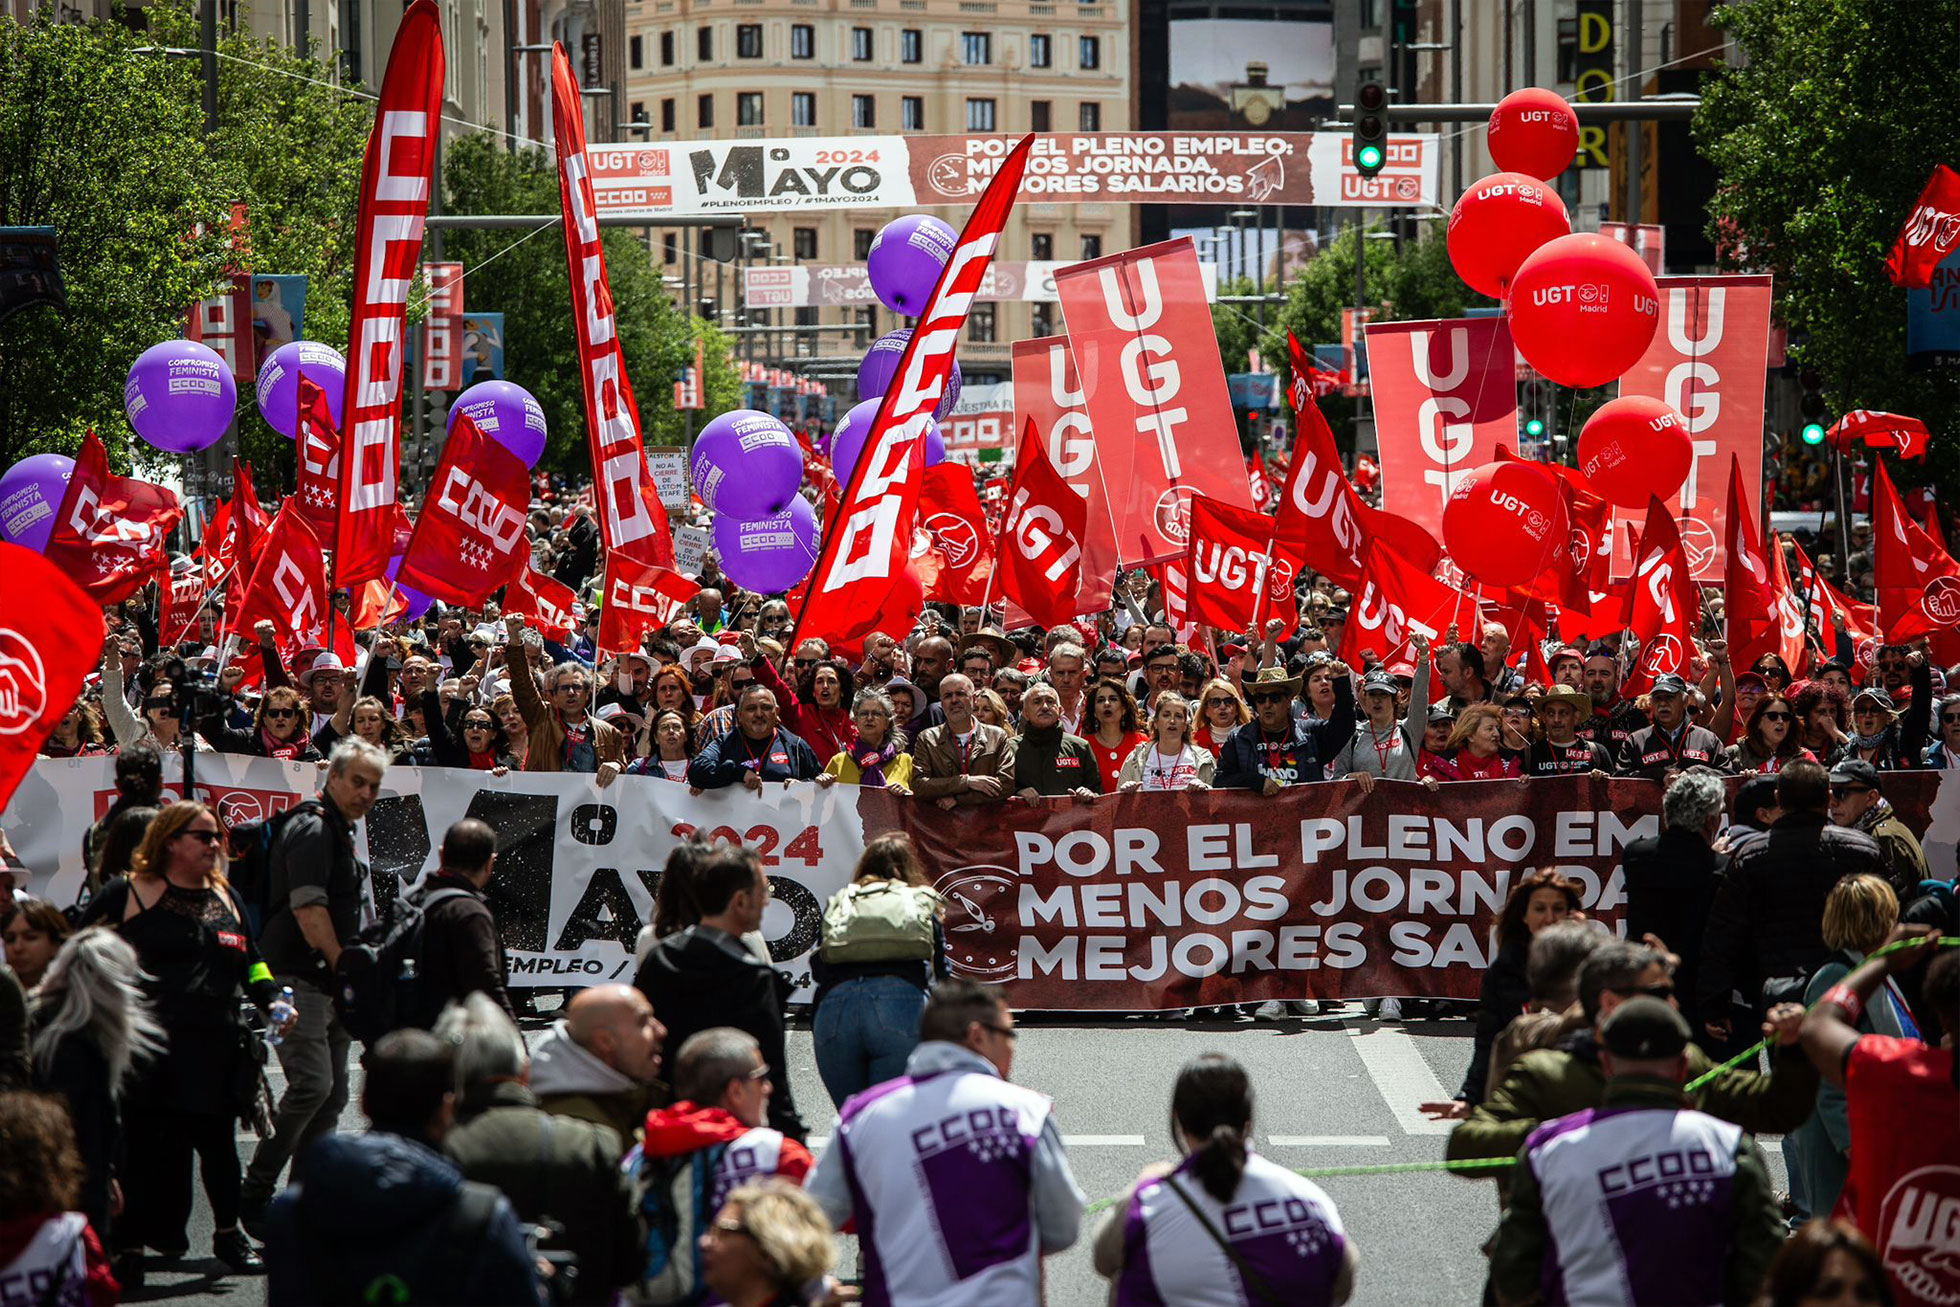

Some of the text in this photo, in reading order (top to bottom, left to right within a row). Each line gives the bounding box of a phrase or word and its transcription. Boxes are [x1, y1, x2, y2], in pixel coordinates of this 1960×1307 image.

[1521, 111, 1550, 122] UGT
[1031, 138, 1066, 155] EL
[1072, 137, 1165, 155] PLENO
[1173, 137, 1294, 155] EMPLEO:
[593, 152, 635, 170] UGT
[816, 150, 880, 164] 2024
[1076, 156, 1218, 175] JORNADA,
[1345, 177, 1395, 198] UGT
[1477, 184, 1516, 200] UGT
[701, 199, 792, 208] #PLENOEMPLEO
[805, 196, 880, 204] #1MAYO2024
[1520, 196, 1542, 206] Madrid
[912, 234, 940, 254] CCOO
[1533, 285, 1575, 306] UGT
[349, 111, 428, 512] CCOO
[1580, 304, 1608, 313] Madrid
[168, 359, 220, 370] COMPROMISO
[169, 367, 219, 379] FEMINISTA
[1099, 257, 1188, 480] UGT
[171, 380, 206, 388] CCOO
[1664, 287, 1726, 508] UGT
[822, 231, 1000, 593] CCOO
[1410, 327, 1474, 510] UGT
[735, 421, 783, 436] FEMINISTA
[1649, 413, 1677, 431] UGT
[743, 432, 775, 446] CCOO
[1583, 455, 1601, 478] UGT
[1, 491, 42, 521] FEMINISTA
[437, 465, 527, 555] CCOO
[1490, 489, 1530, 517] UGT
[741, 520, 791, 533] FEMINISTA
[1522, 523, 1543, 541] Madrid
[679, 540, 702, 549] CIERRE
[742, 535, 776, 546] CCOO
[1194, 539, 1271, 595] UGT
[1539, 761, 1558, 771] UGT
[1643, 753, 1660, 764] UGT
[1013, 828, 1164, 877] POR
[1186, 822, 1279, 871] EL
[1301, 814, 1536, 864] PLENO
[1017, 875, 1289, 929] MENOS
[1017, 921, 1367, 982] MEJORES
[912, 1108, 1019, 1152] CCOO
[1600, 1150, 1715, 1196] CCOO
